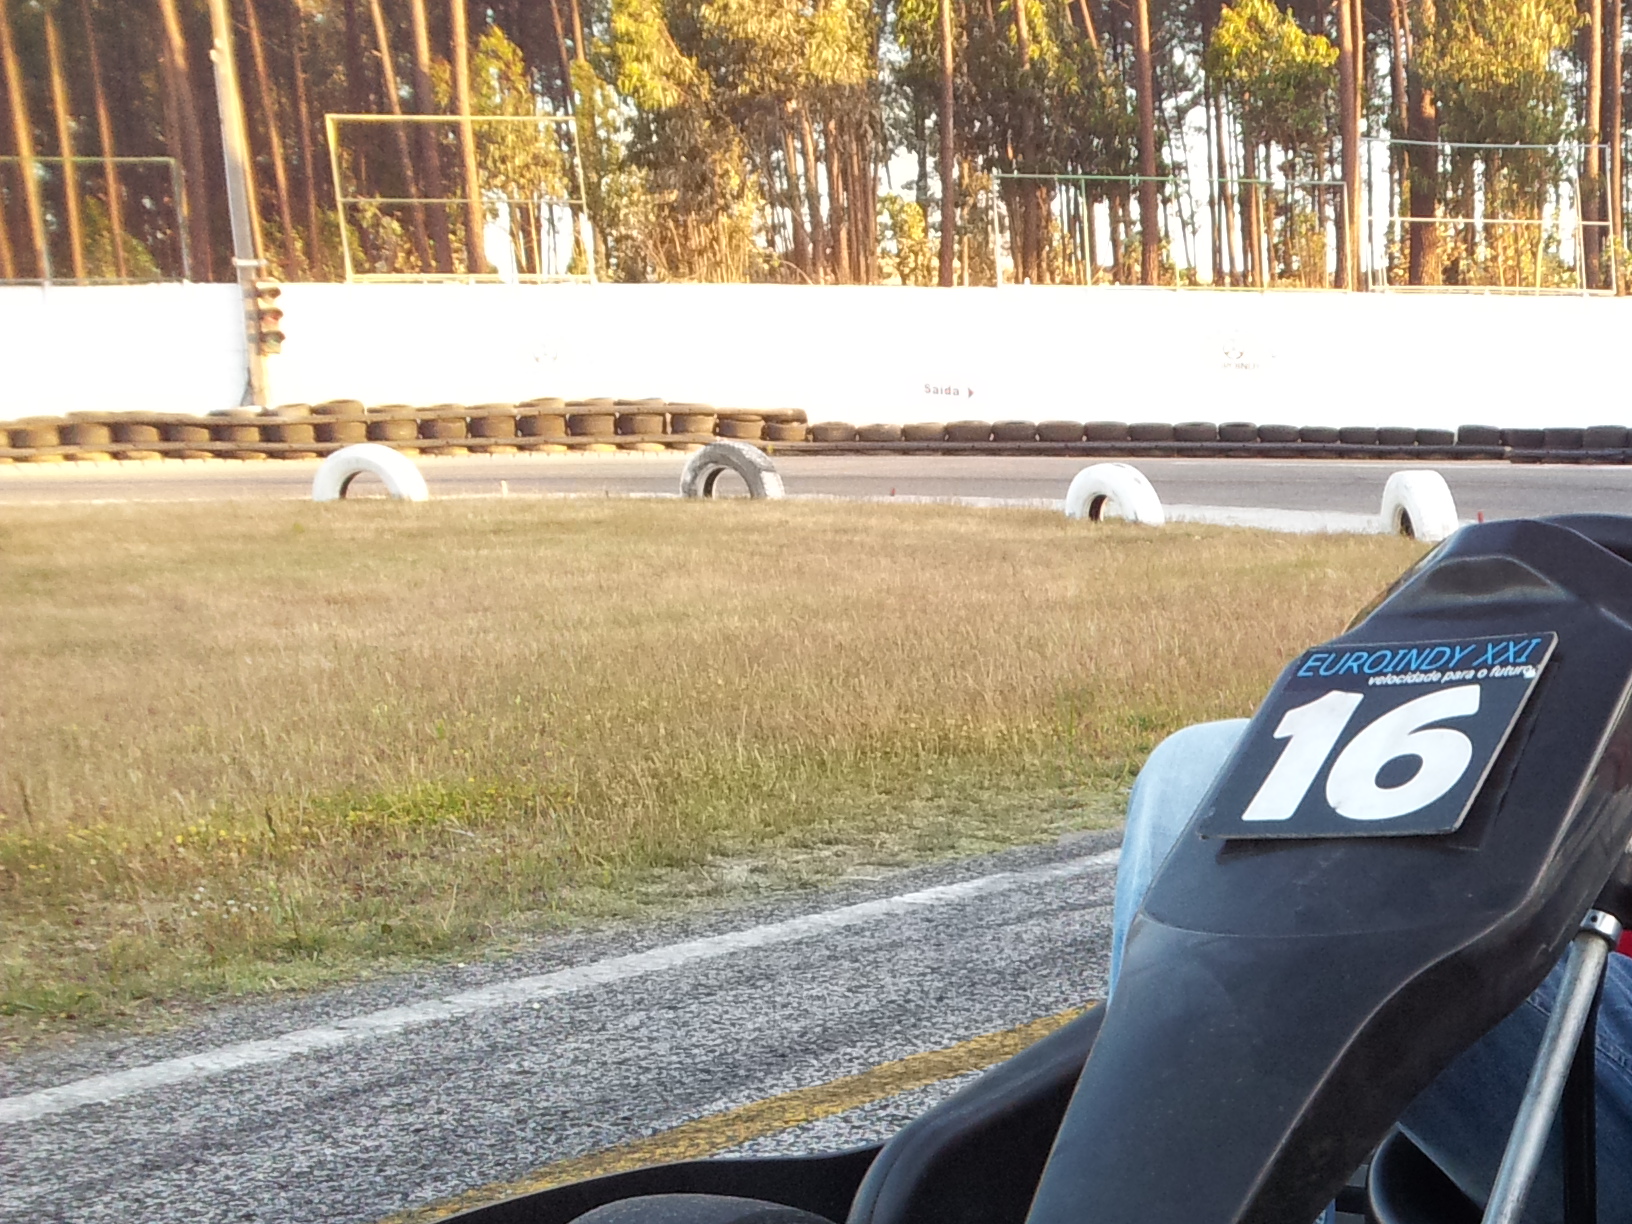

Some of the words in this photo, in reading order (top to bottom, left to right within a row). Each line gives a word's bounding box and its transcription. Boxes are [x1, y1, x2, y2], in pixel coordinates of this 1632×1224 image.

[1297, 644, 1477, 677] EUROINDY
[1472, 638, 1542, 666] XXI
[1367, 670, 1442, 686] velocidade
[1440, 668, 1476, 684] para
[1476, 667, 1488, 679] o
[1488, 663, 1535, 679] futuro
[1241, 684, 1481, 821] 16
